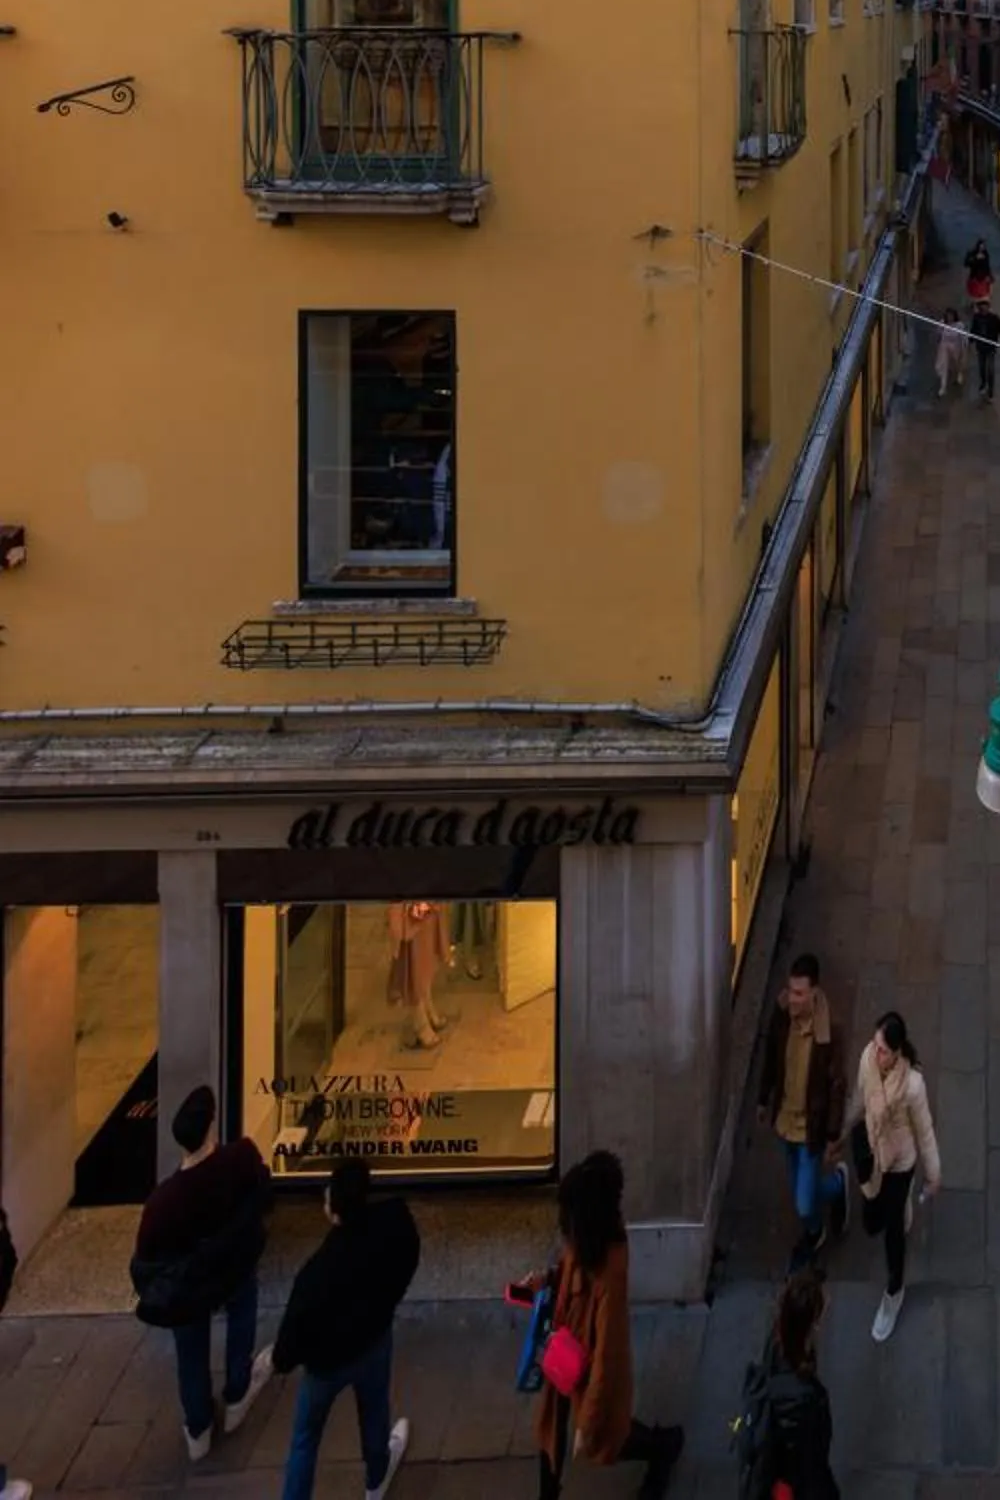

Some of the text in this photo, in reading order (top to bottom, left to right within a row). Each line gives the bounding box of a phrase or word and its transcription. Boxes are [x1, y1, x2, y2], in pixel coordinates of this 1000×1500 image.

[288, 802, 340, 848] al
[347, 800, 464, 848] duca
[343, 1123, 410, 1137] NEW YORK
[274, 1139, 478, 1157] ALEXANDER WANG
